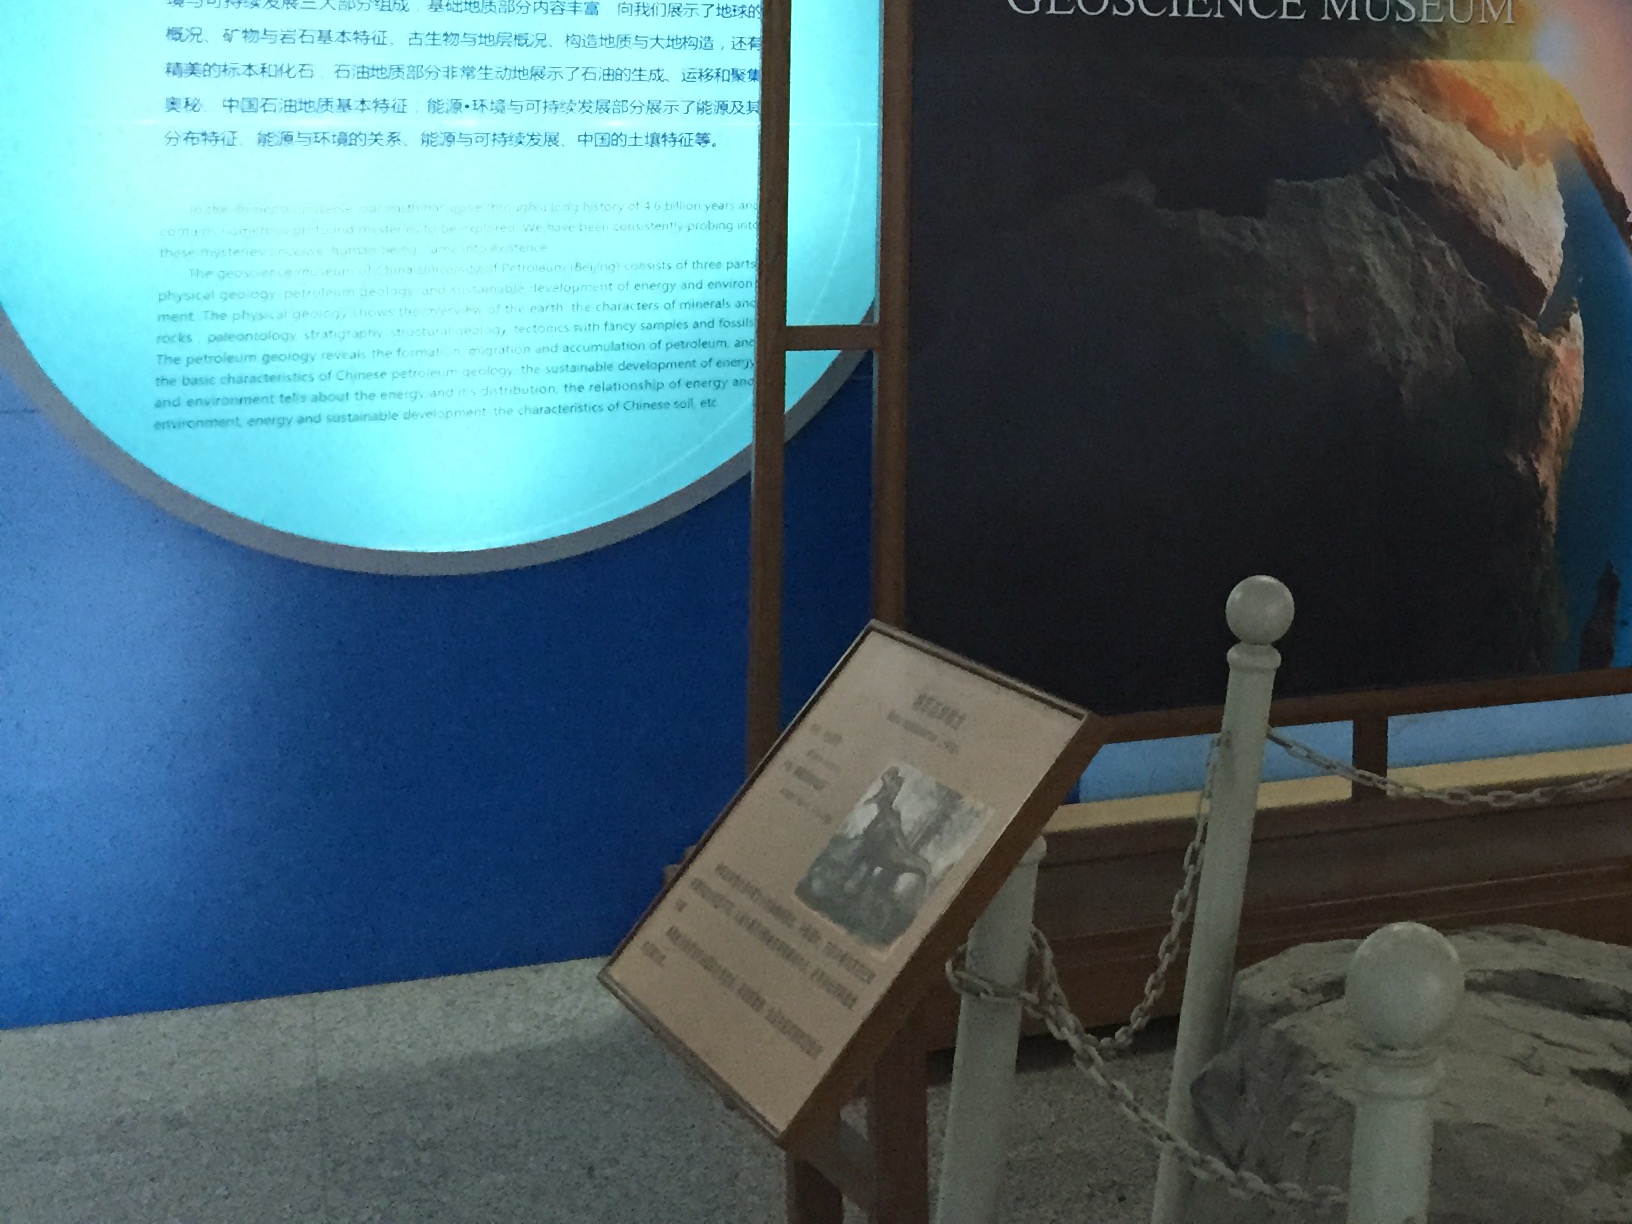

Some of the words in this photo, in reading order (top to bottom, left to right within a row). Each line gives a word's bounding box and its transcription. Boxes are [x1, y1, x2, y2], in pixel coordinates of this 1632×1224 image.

[207, 204, 227, 214] the
[582, 200, 624, 214] history
[628, 200, 640, 211] of
[665, 200, 701, 211] billion
[705, 202, 734, 213] years
[523, 222, 542, 233] We
[547, 222, 574, 233] have
[579, 221, 609, 232] been
[614, 221, 683, 235] consistently
[688, 220, 733, 234] probing
[160, 246, 193, 258] these
[201, 246, 264, 260] mysteries
[189, 267, 212, 279] The
[218, 266, 291, 281] geoscience
[298, 268, 353, 277] museum
[377, 264, 413, 275] China
[503, 261, 565, 273] Petroleum
[571, 260, 620, 275] (Beijing)
[625, 259, 671, 271] consists
[676, 259, 687, 270] of
[692, 258, 721, 270] three
[158, 289, 214, 304] physical
[284, 286, 355, 301] petroleum
[530, 281, 613, 296] development
[618, 281, 629, 292] of
[634, 282, 676, 294] energy
[681, 279, 703, 290] and
[203, 310, 227, 321] The
[233, 309, 287, 324] physical
[293, 307, 347, 322] geology
[355, 306, 392, 317] shows
[399, 305, 418, 316] the
[505, 303, 524, 314] the
[572, 301, 591, 312] the
[596, 299, 659, 311] characters
[664, 299, 675, 310] of
[680, 297, 730, 309] minerals
[157, 332, 193, 344] rocks
[391, 325, 451, 337] structural
[514, 322, 569, 334] tectonics
[574, 321, 600, 333] with
[604, 320, 636, 335] fancy
[640, 319, 688, 334] samples
[693, 318, 715, 329] and
[157, 354, 181, 366] The
[186, 352, 256, 368] petroleum
[262, 350, 316, 365] geology
[321, 349, 366, 360] reveals
[372, 348, 392, 359] the
[469, 343, 531, 359] migration
[536, 342, 558, 354] and
[563, 340, 645, 353] accumulation
[650, 339, 661, 350] of
[156, 376, 176, 387] the
[182, 374, 215, 386] basic
[220, 371, 314, 384] characteristics
[319, 370, 332, 381] of
[336, 368, 387, 381] Chinese
[392, 366, 457, 382] petroleum
[521, 363, 540, 375] the
[545, 361, 613, 374] sustainable
[618, 358, 696, 374] development
[701, 357, 712, 369] of
[716, 359, 756, 371] energy
[155, 396, 180, 408] and
[187, 393, 274, 406] environment
[279, 392, 306, 403] tells
[311, 390, 350, 402] about
[355, 389, 375, 401] the
[380, 390, 424, 403] energy
[430, 386, 454, 398] and
[564, 382, 584, 393] the
[589, 379, 664, 395] relationship
[670, 378, 681, 389] of
[686, 379, 728, 391] energy
[246, 417, 292, 430] energy
[298, 413, 322, 425] and
[327, 410, 399, 424] sustainable
[494, 406, 513, 417] the
[518, 402, 604, 416] characteristics
[608, 401, 620, 412] of
[623, 399, 670, 412] Chinese
